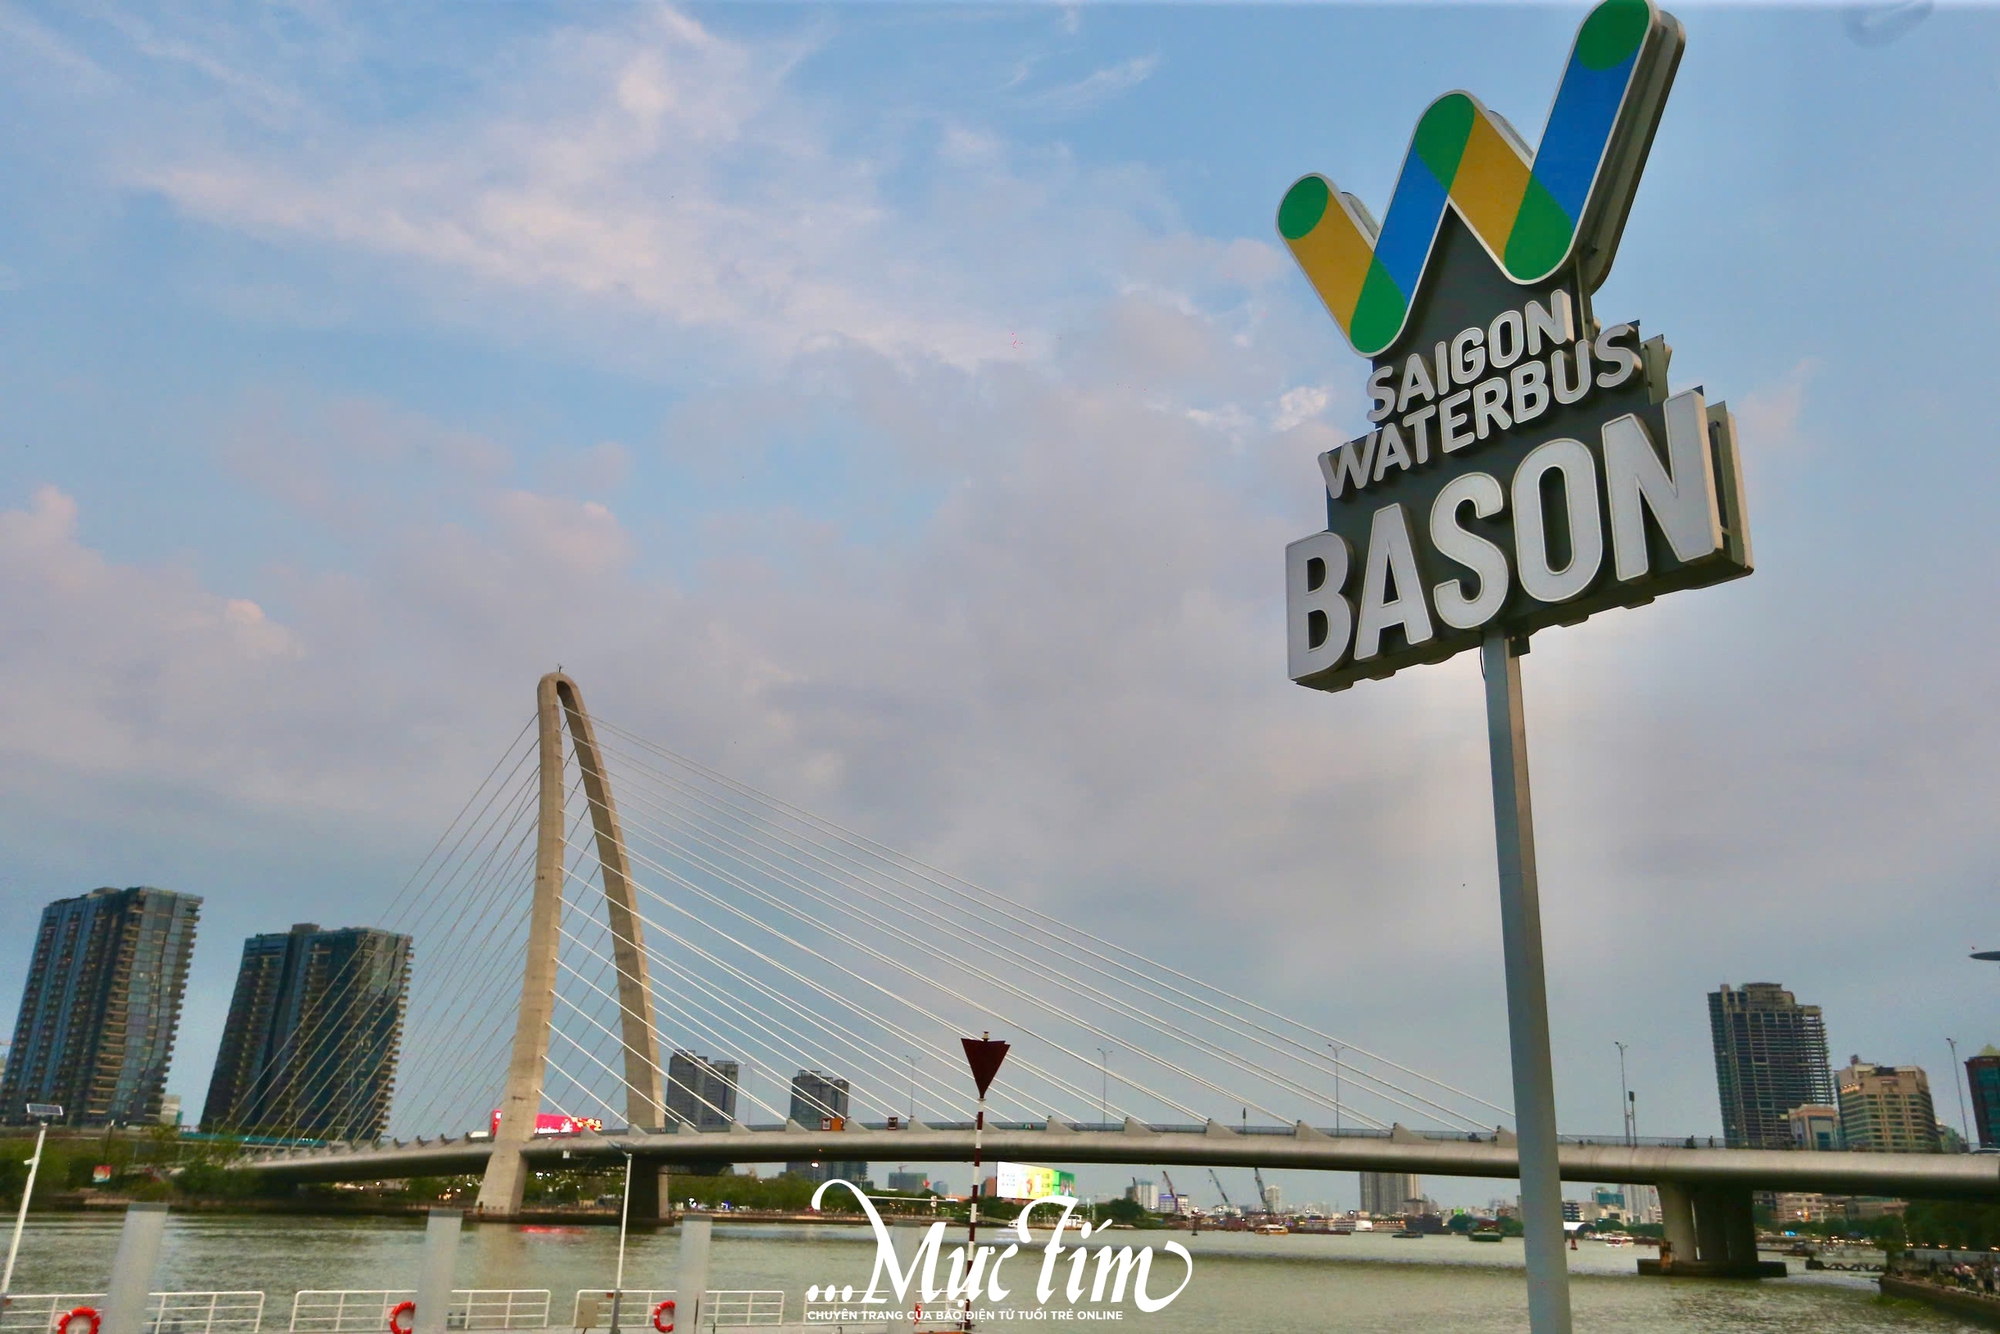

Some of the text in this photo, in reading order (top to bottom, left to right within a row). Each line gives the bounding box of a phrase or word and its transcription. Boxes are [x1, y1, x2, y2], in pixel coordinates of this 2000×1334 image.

[1317, 322, 1641, 499] WATERBUS
[1366, 288, 1571, 423] SAIGON
[1285, 387, 1722, 681] BASON
